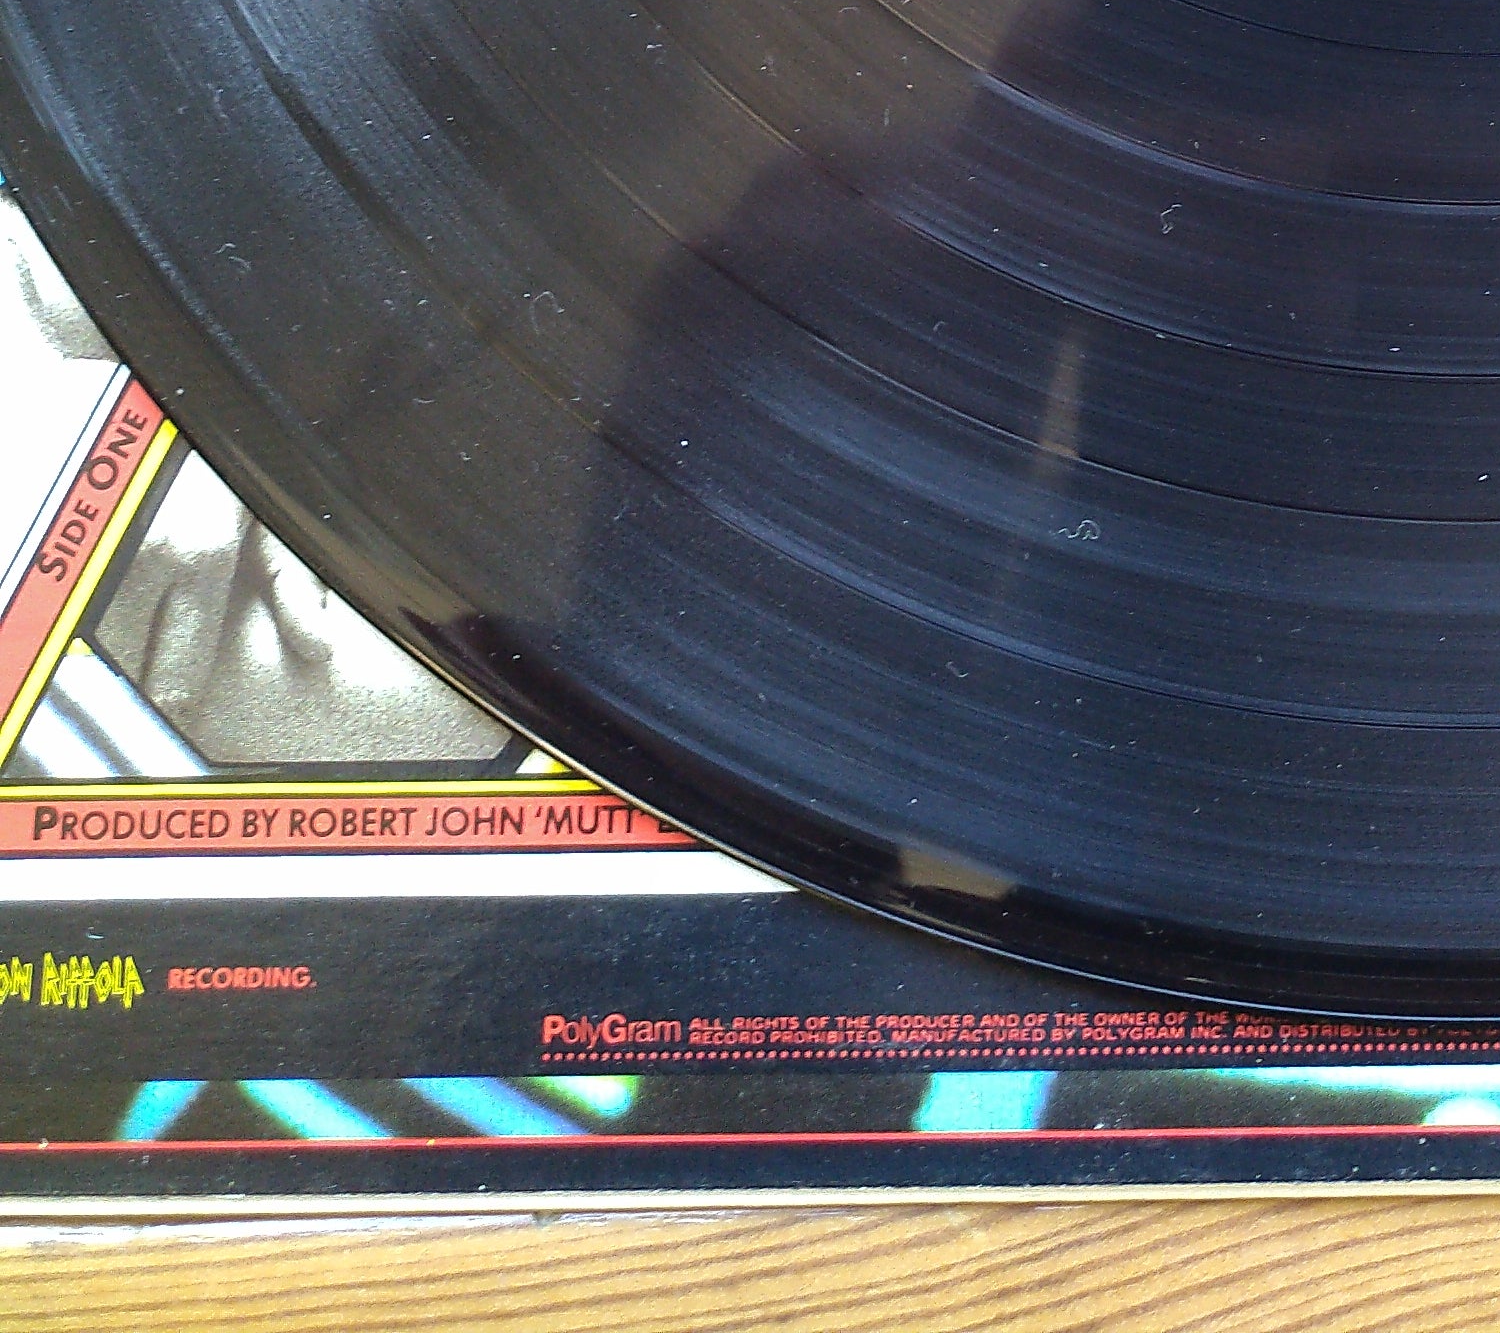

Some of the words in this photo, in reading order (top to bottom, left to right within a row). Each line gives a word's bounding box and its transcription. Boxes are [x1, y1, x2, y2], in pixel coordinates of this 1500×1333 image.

[35, 499, 99, 582] SIDE
[87, 409, 148, 491] ONE
[33, 805, 231, 842] PRODUCED
[241, 808, 280, 839] BY
[289, 807, 414, 837] ROBERT
[425, 806, 526, 836] JOHN
[167, 966, 318, 992] RECORDING.
[542, 1013, 681, 1050] PolyGram
